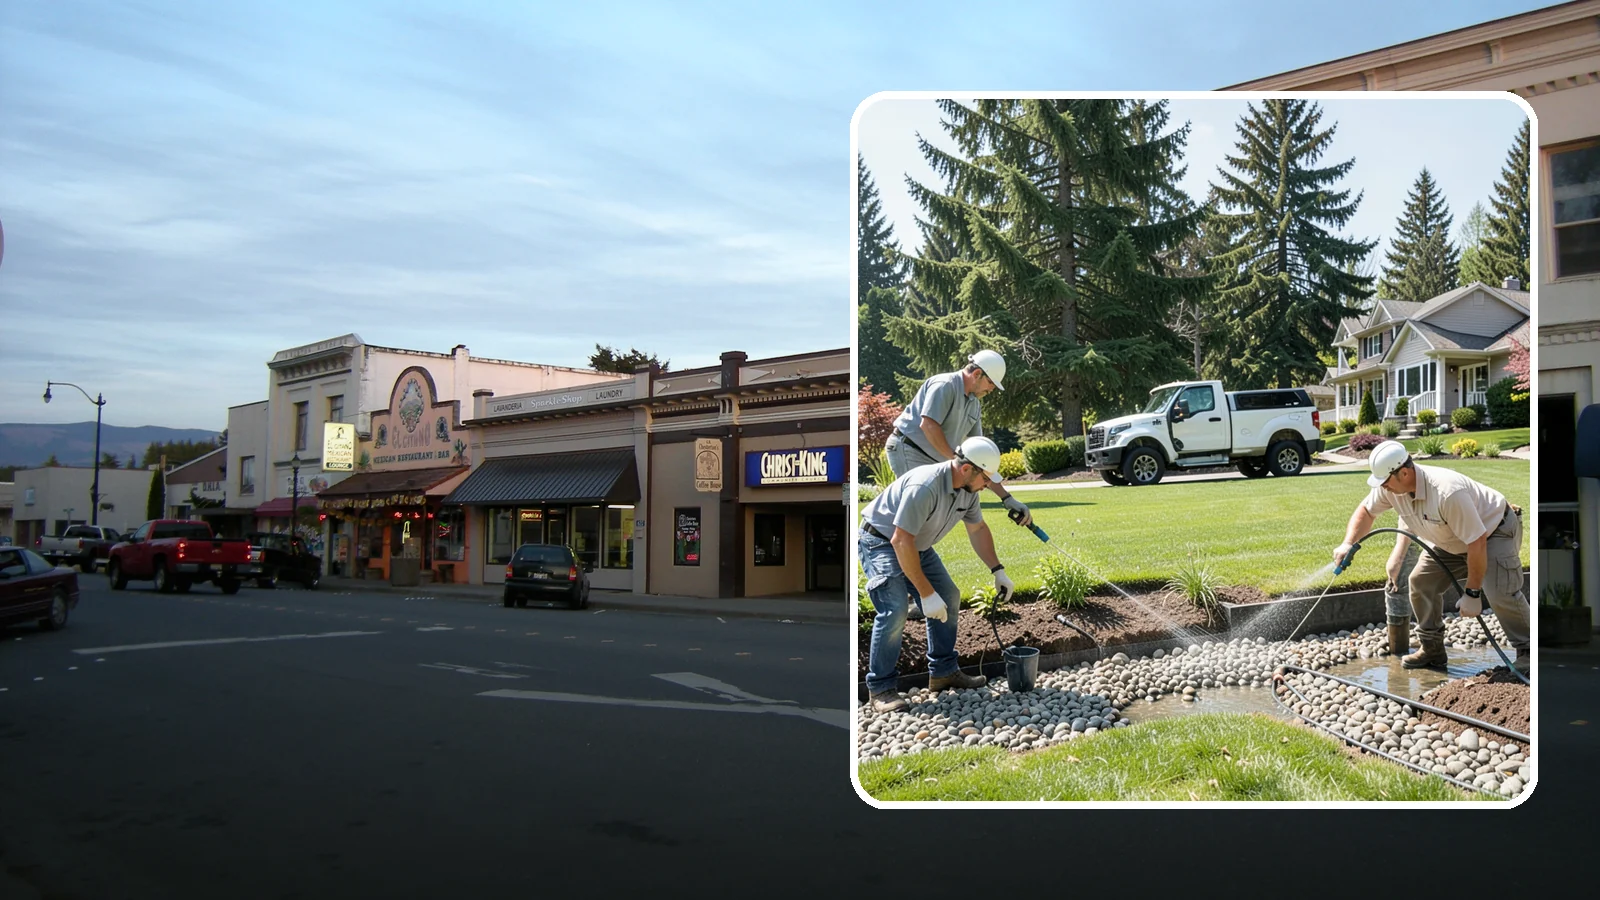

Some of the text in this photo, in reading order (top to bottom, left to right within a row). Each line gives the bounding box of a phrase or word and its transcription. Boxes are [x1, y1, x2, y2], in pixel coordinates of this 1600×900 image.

[531, 394, 583, 409] Sparkle Shop
[595, 389, 624, 400] LAUNDRY
[493, 402, 523, 413] LAVANDERIA
[373, 454, 396, 464] MEXICAN
[397, 452, 433, 462] RESTAURANT
[437, 450, 450, 459] BAR
[760, 450, 827, 478] CHRIST KING
